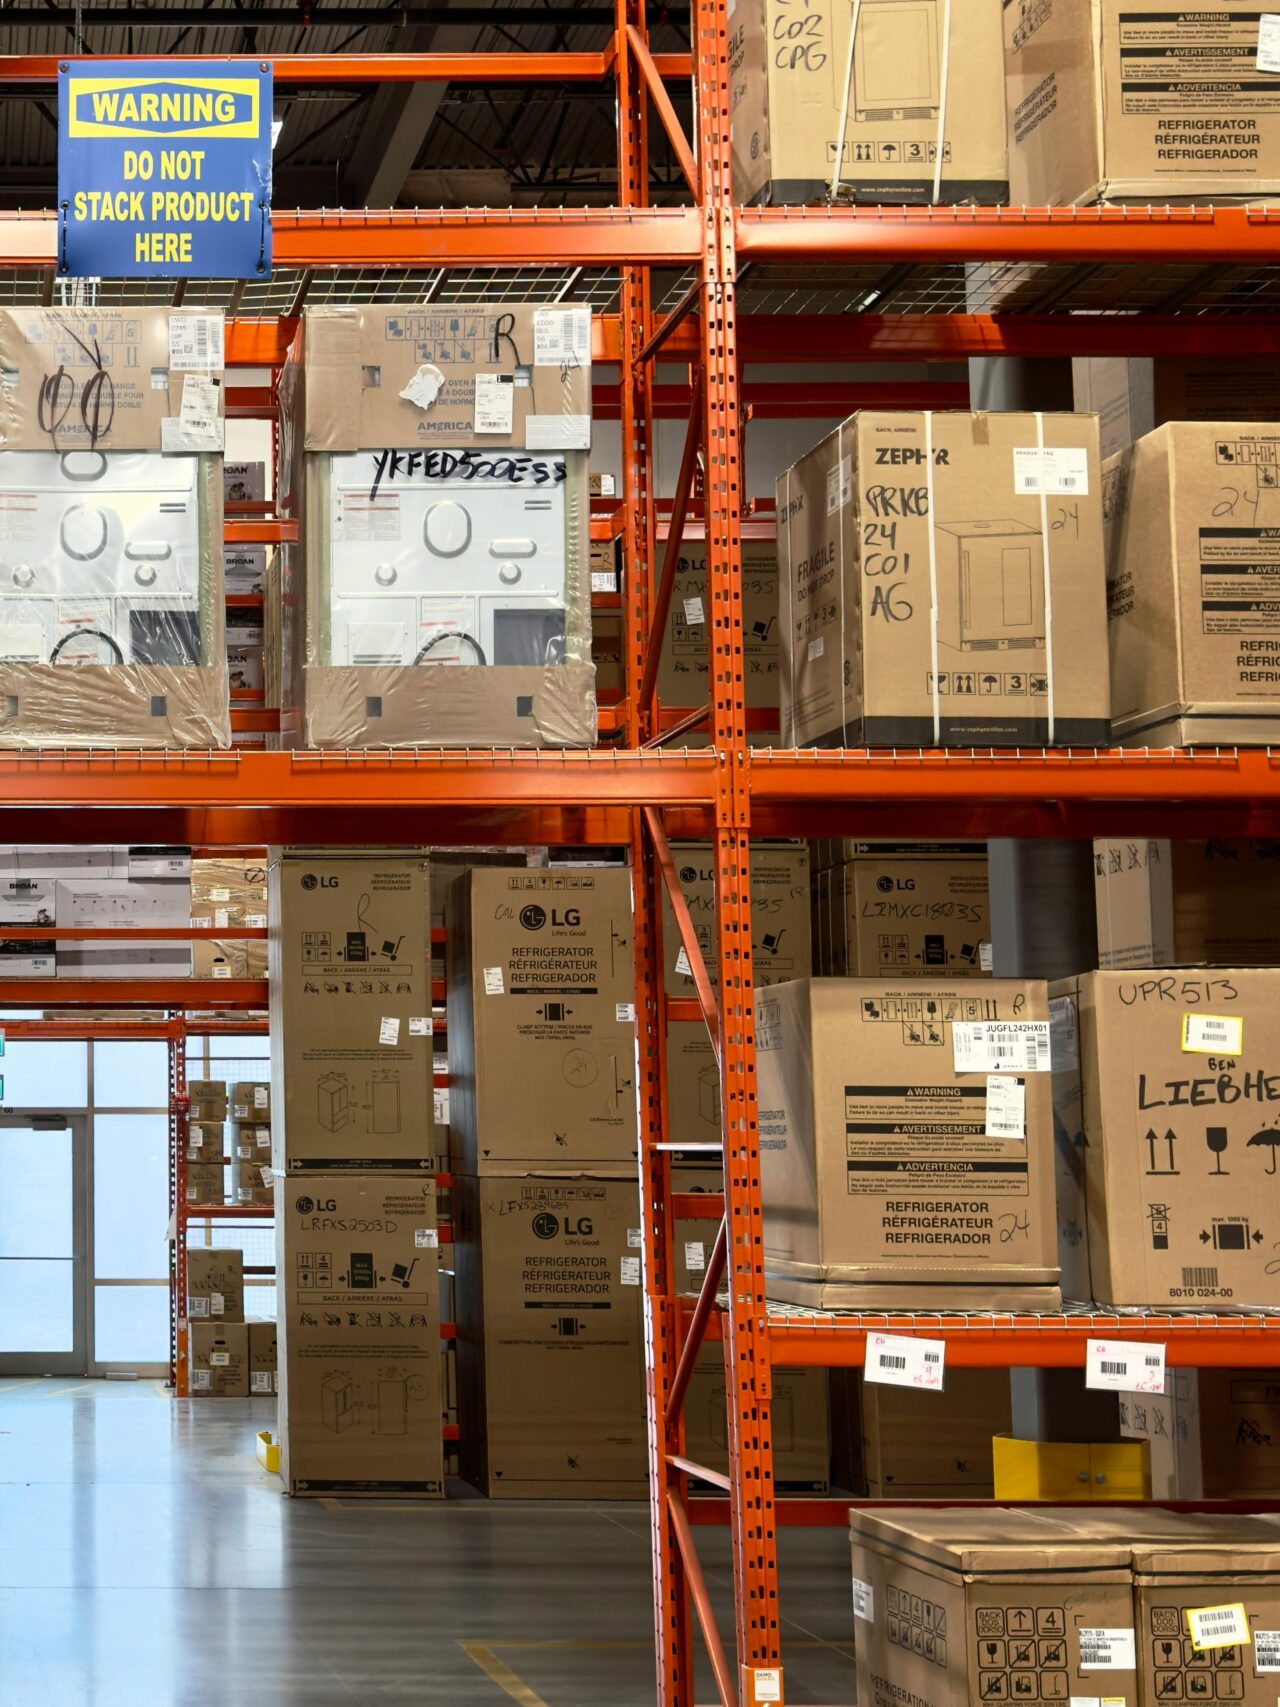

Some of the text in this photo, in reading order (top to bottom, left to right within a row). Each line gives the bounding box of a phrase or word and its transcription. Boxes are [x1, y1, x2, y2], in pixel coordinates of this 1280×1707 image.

[1185, 13, 1230, 21] WARNING
[775, 41, 827, 71] CPG
[1173, 48, 1249, 56] AVERTISSEMENT
[1176, 83, 1242, 91] ADVERTENCIA
[92, 93, 236, 122] WARNING
[1158, 120, 1256, 130] REFRIGERATOR
[1154, 132, 1261, 145] RÉFRIGÉRATEUR
[1157, 149, 1258, 159] REFRIGERADOR
[123, 151, 205, 180] DO NOT
[74, 192, 252, 222] STACK PRODUCT
[135, 232, 192, 262] HERE
[494, 313, 521, 365] R
[417, 422, 473, 430] AMERICA
[863, 522, 897, 547] 24
[226, 557, 255, 565] BROAN
[798, 542, 835, 583] FRAGILE
[869, 581, 913, 622] AG
[1011, 676, 1022, 690] 3
[9, 882, 38, 890] BROAN
[321, 876, 339, 889] LG
[897, 879, 915, 890] LG
[552, 909, 580, 926] LG
[512, 948, 593, 957] REFRIGERATOR
[509, 958, 597, 969] RÉFRIGÉRATEUR
[511, 973, 596, 982] REFRIGERADOR
[985, 1024, 1047, 1033] JUGFL242HX01
[1208, 1057, 1237, 1071] BEN
[914, 1088, 961, 1096] WARNING
[902, 1125, 982, 1134] AVERTISSEMENT
[906, 1163, 973, 1171] ADVERTENCIA
[317, 1199, 337, 1212] LG
[886, 1202, 989, 1213] REFRIGERATOR
[564, 1217, 593, 1235] LG
[882, 1215, 993, 1228] RÉFRIGÉRATEUR
[999, 1208, 1031, 1244] 24
[885, 1233, 991, 1244] REFRIGERADOR
[525, 1257, 607, 1267] REFRIGERATOR
[523, 1268, 611, 1280] RÉFRIGÉRATEUR
[525, 1284, 609, 1293] REFRIGERADOR
[1169, 1287, 1233, 1297] 8010 024-00
[1045, 1611, 1057, 1627] 4
[1153, 1610, 1176, 1618] BACK
[1153, 1625, 1178, 1633] DORSO
